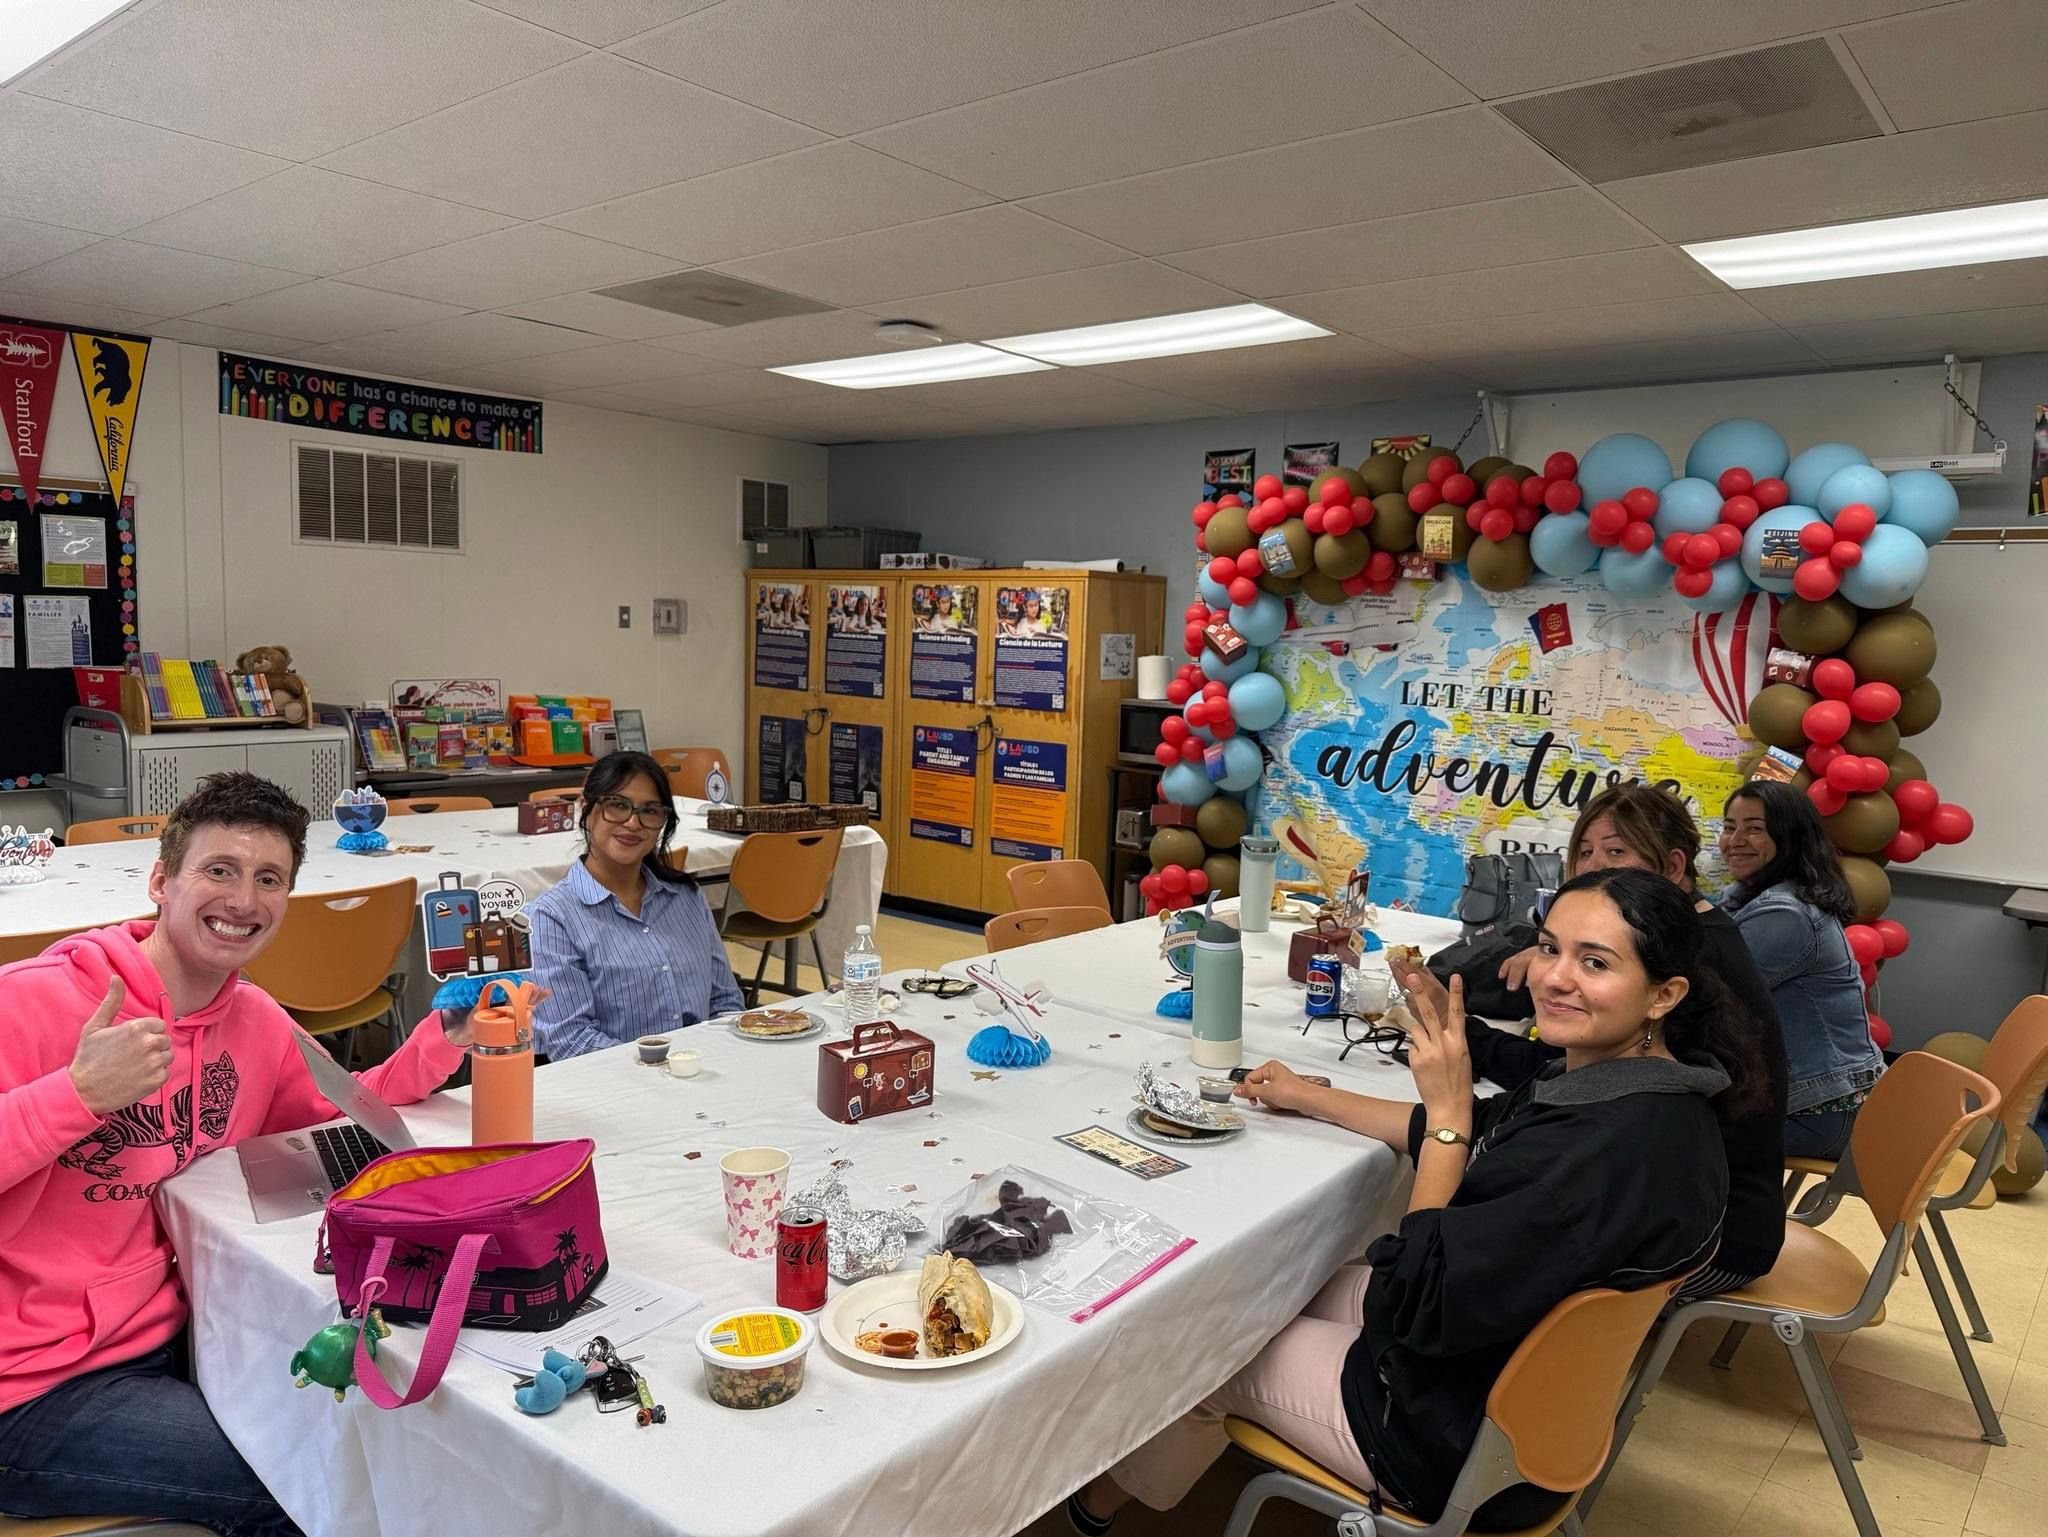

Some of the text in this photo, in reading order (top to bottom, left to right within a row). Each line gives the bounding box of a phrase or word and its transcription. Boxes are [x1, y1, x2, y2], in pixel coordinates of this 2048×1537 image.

[233, 364, 532, 419] EVERYONE has a chance to make a
[15, 377, 39, 458] Stanford
[289, 393, 492, 442] DIFFERENCE
[104, 415, 125, 473] California
[1206, 465, 1252, 483] BEST
[1400, 680, 1553, 716] LET THE
[926, 730, 954, 741] LAUSD
[1009, 743, 1040, 754] LAUSD
[1317, 719, 1692, 812] adventu
[480, 891, 502, 900] BON
[480, 898, 520, 911] voyage
[1167, 935, 1196, 946] ADVENTURE
[1307, 983, 1333, 994] EPSI
[81, 1182, 158, 1203] COAC
